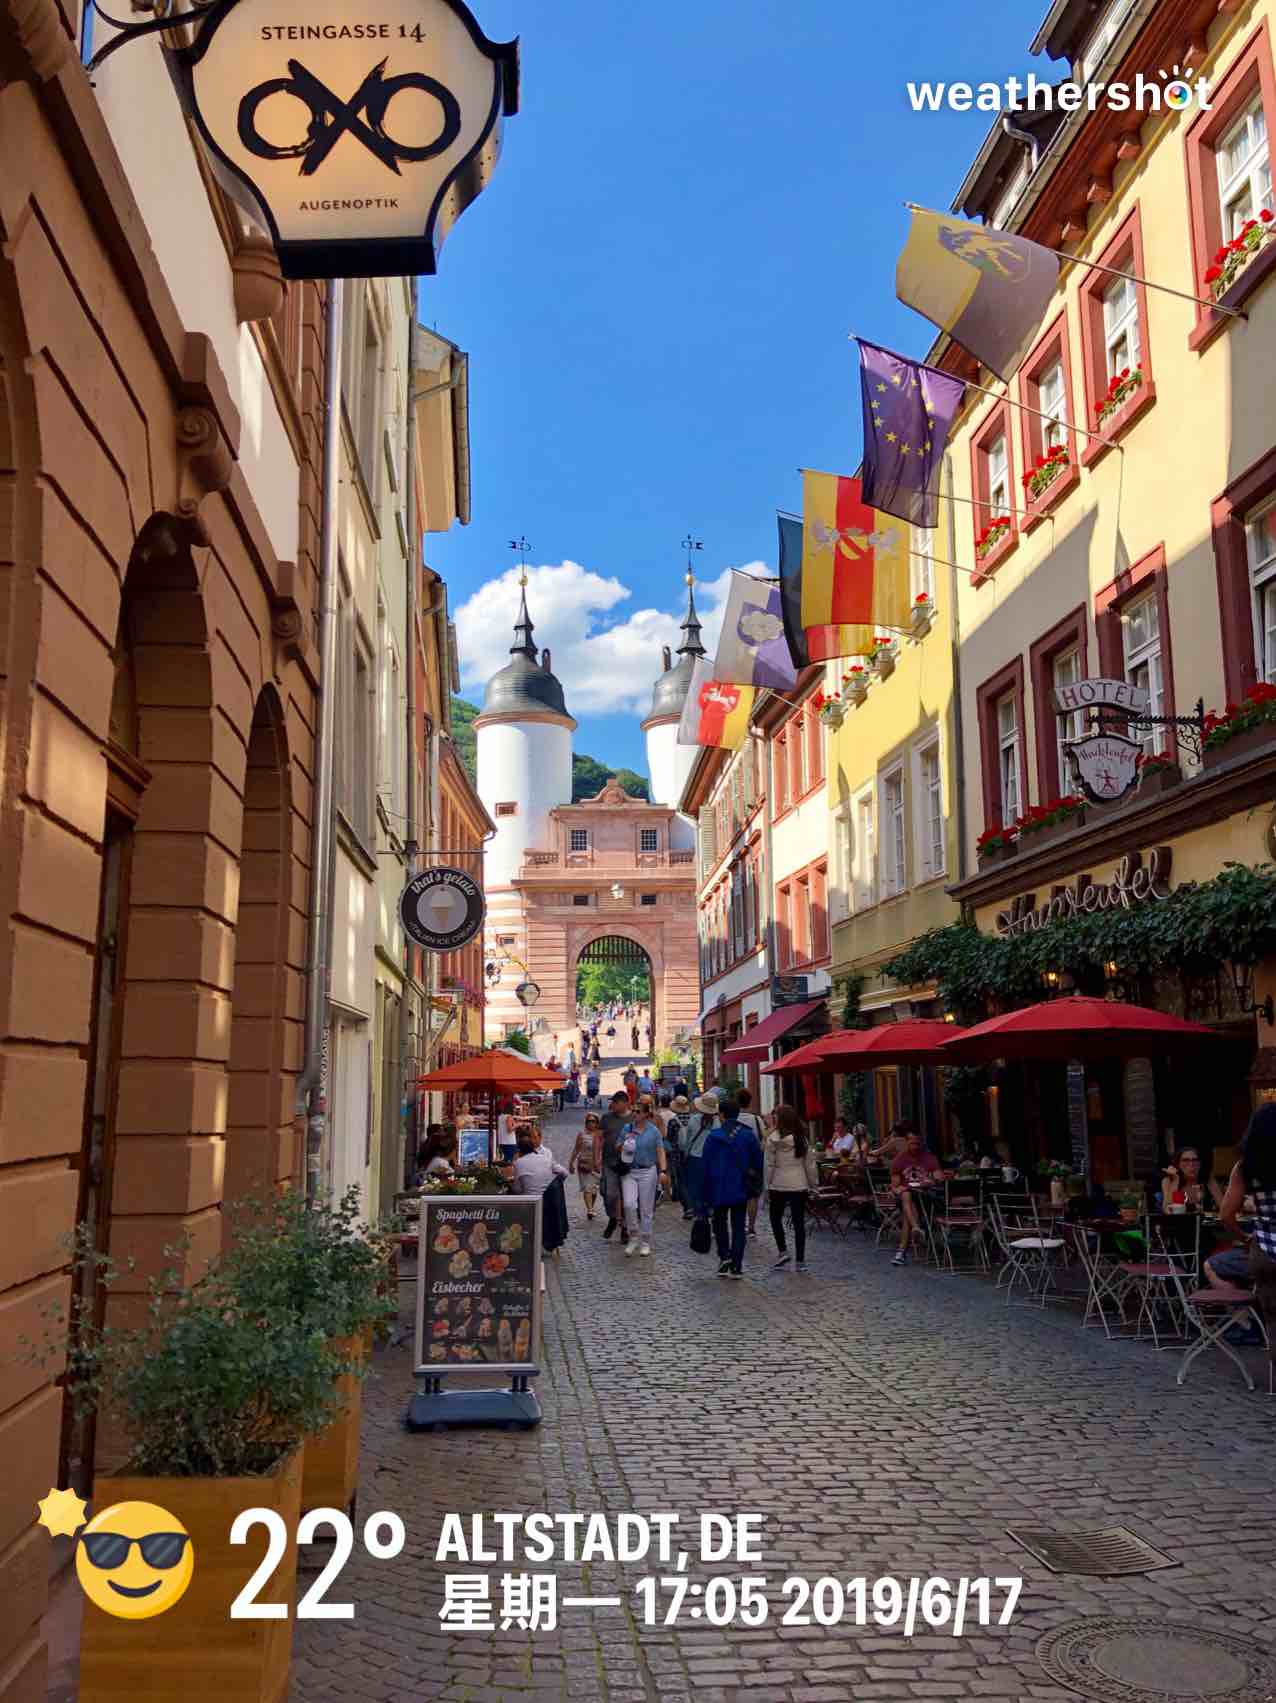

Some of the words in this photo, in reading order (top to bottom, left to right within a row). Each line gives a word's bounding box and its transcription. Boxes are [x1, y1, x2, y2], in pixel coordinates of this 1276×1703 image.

[261, 24, 390, 41] STEINGASSE
[398, 22, 426, 43] 14
[299, 198, 399, 211] AUGENOPTIK
[1061, 682, 1143, 709] HOTEL
[432, 1281, 485, 1294] Eisbecher
